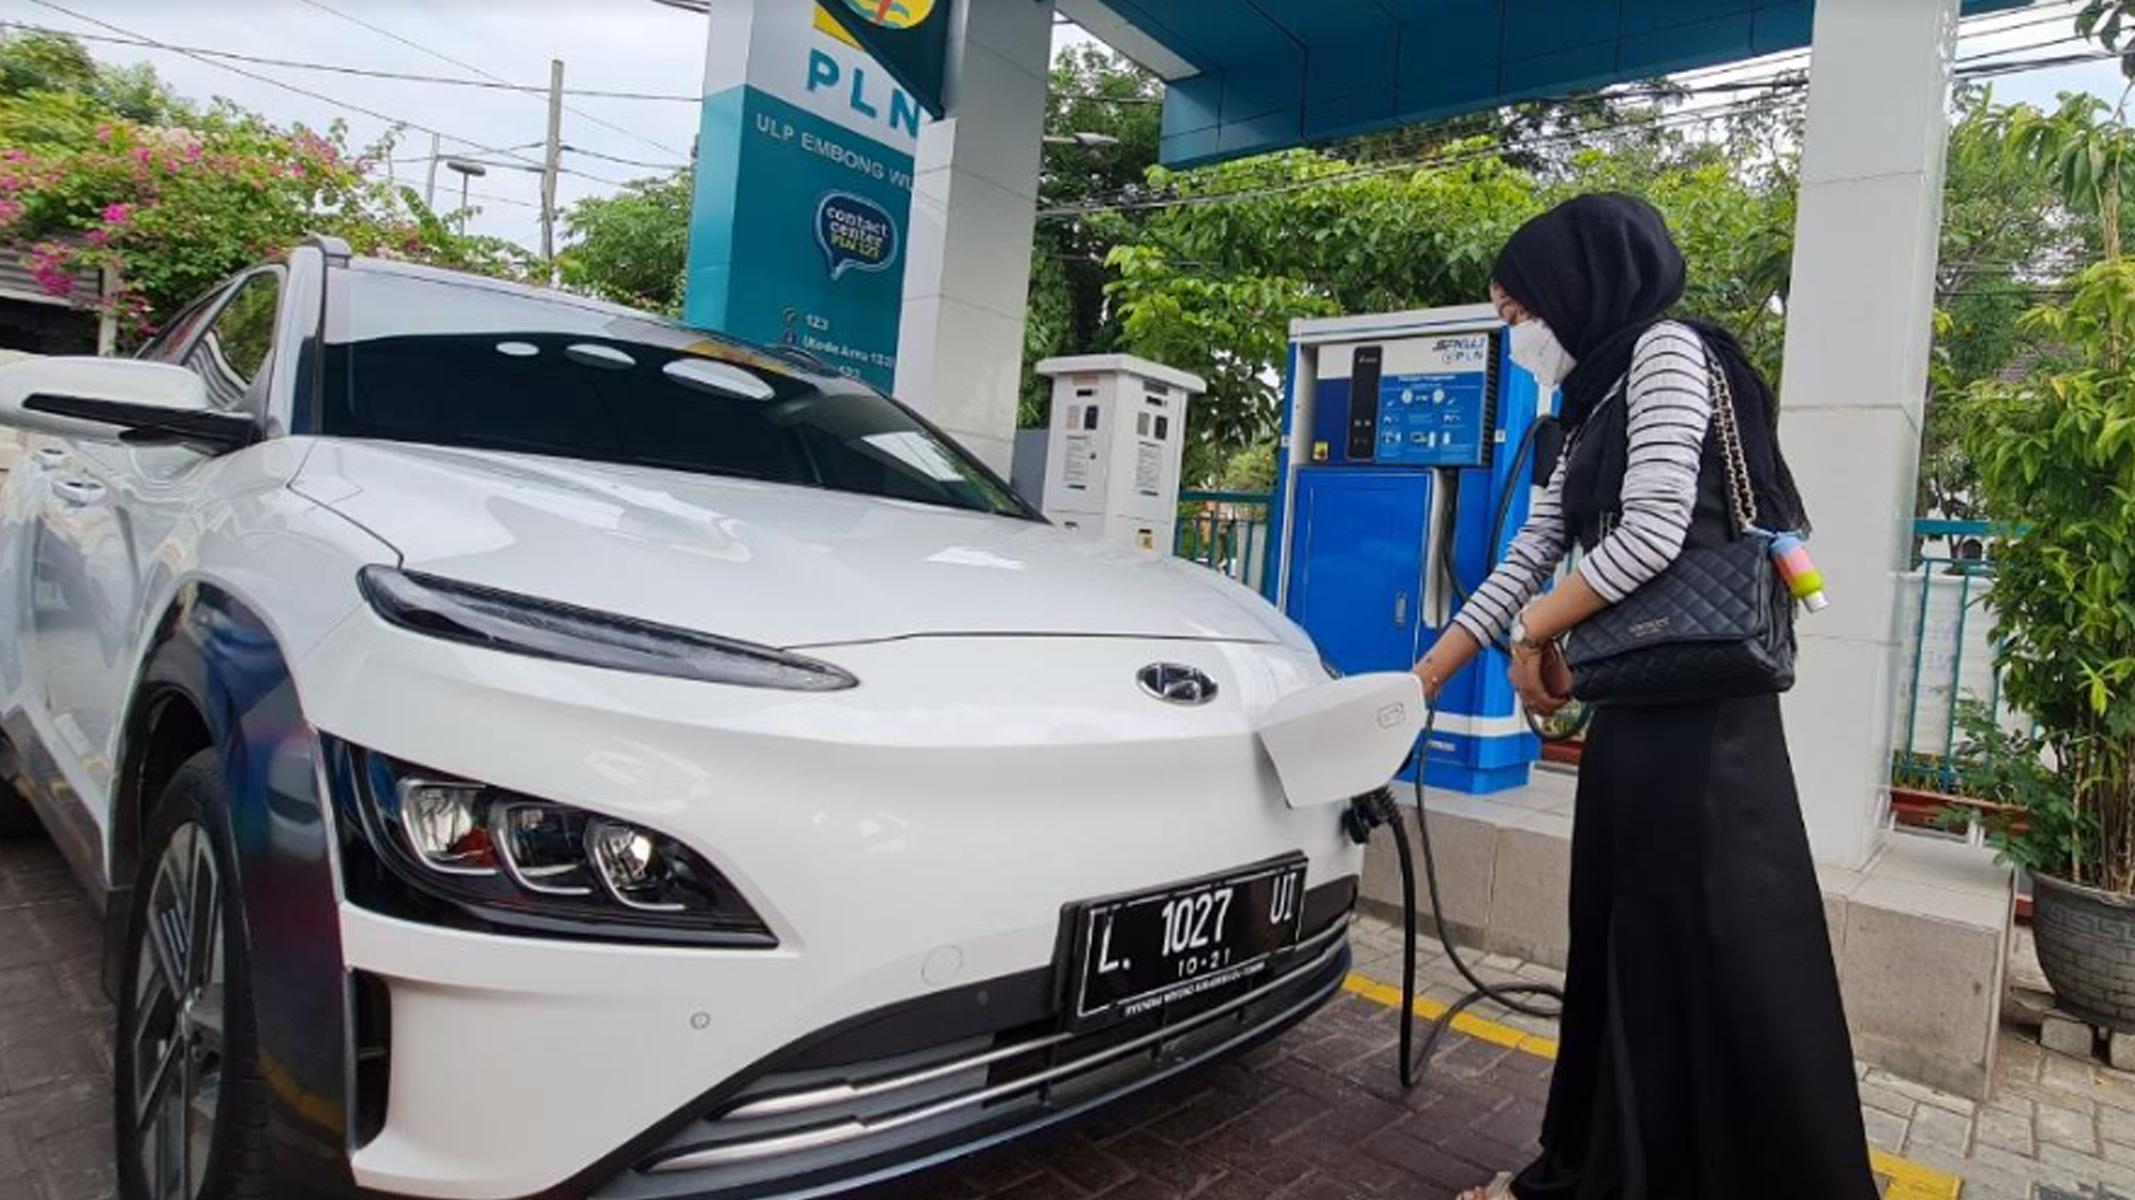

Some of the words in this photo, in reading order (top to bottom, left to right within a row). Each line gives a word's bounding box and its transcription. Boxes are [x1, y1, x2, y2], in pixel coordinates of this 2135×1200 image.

[807, 48, 920, 139] PLN
[756, 112, 794, 141] ULP
[801, 132, 885, 180] EMBONG
[826, 207, 889, 239] contact
[830, 221, 882, 248] center
[805, 313, 830, 331] 123
[1161, 887, 1234, 956] 1027
